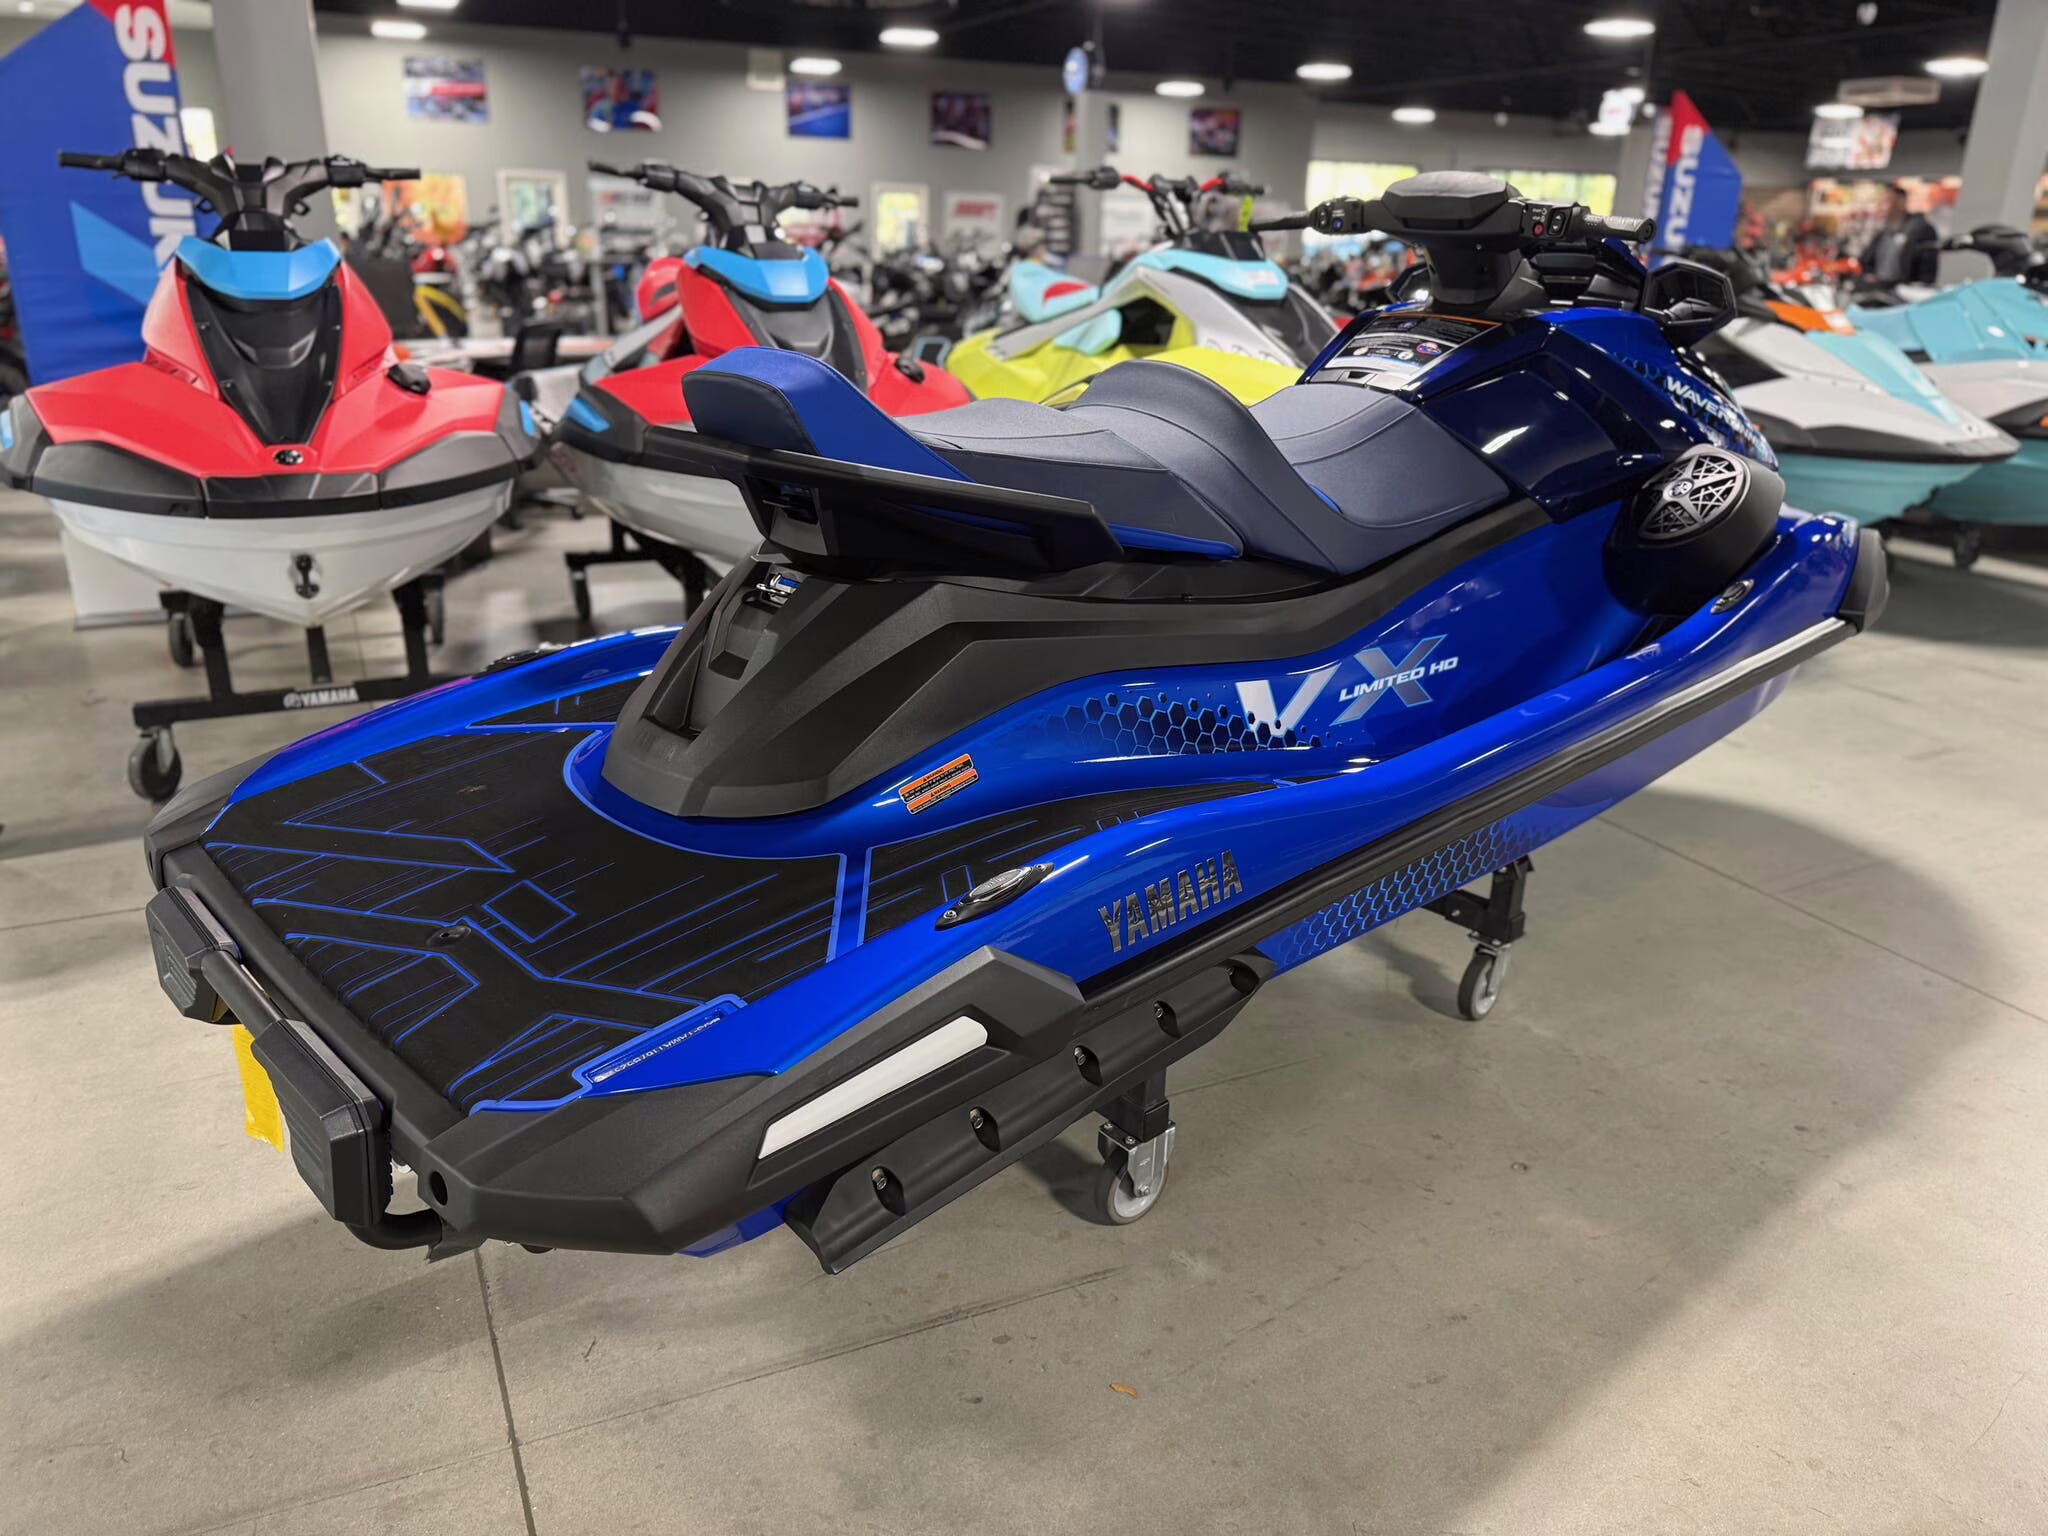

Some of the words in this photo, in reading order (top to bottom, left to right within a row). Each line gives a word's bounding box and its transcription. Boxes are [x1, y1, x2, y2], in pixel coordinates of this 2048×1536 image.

[114, 4, 196, 270] SUZUK
[1662, 125, 1704, 256] SUZU
[300, 687, 359, 706] YAMAHA
[1339, 666, 1424, 702] LIMITED
[1429, 656, 1459, 676] HD
[1098, 850, 1243, 952] YAMAHA
